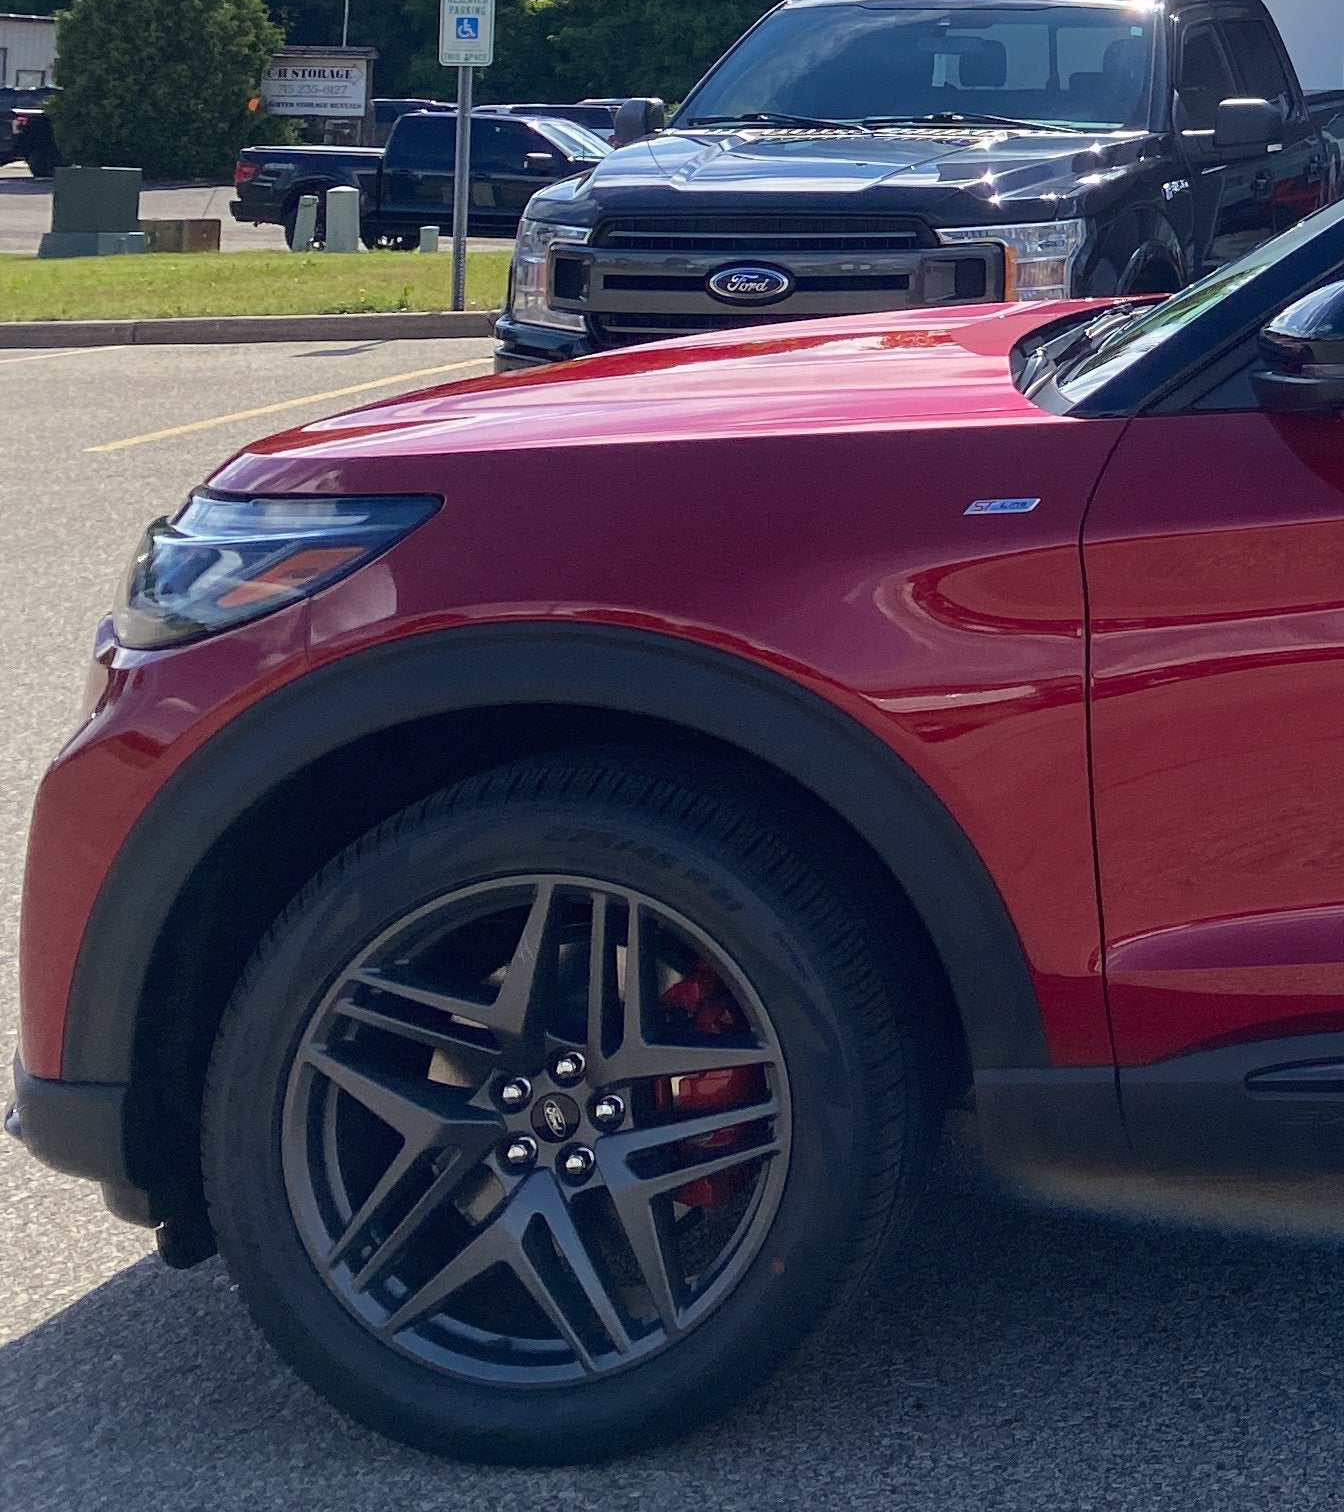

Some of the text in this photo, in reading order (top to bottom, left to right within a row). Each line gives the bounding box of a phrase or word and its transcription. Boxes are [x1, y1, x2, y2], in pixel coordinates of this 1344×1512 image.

[449, 5, 486, 15] PARKING
[291, 68, 353, 80] STORAGE
[726, 273, 770, 292] Ford
